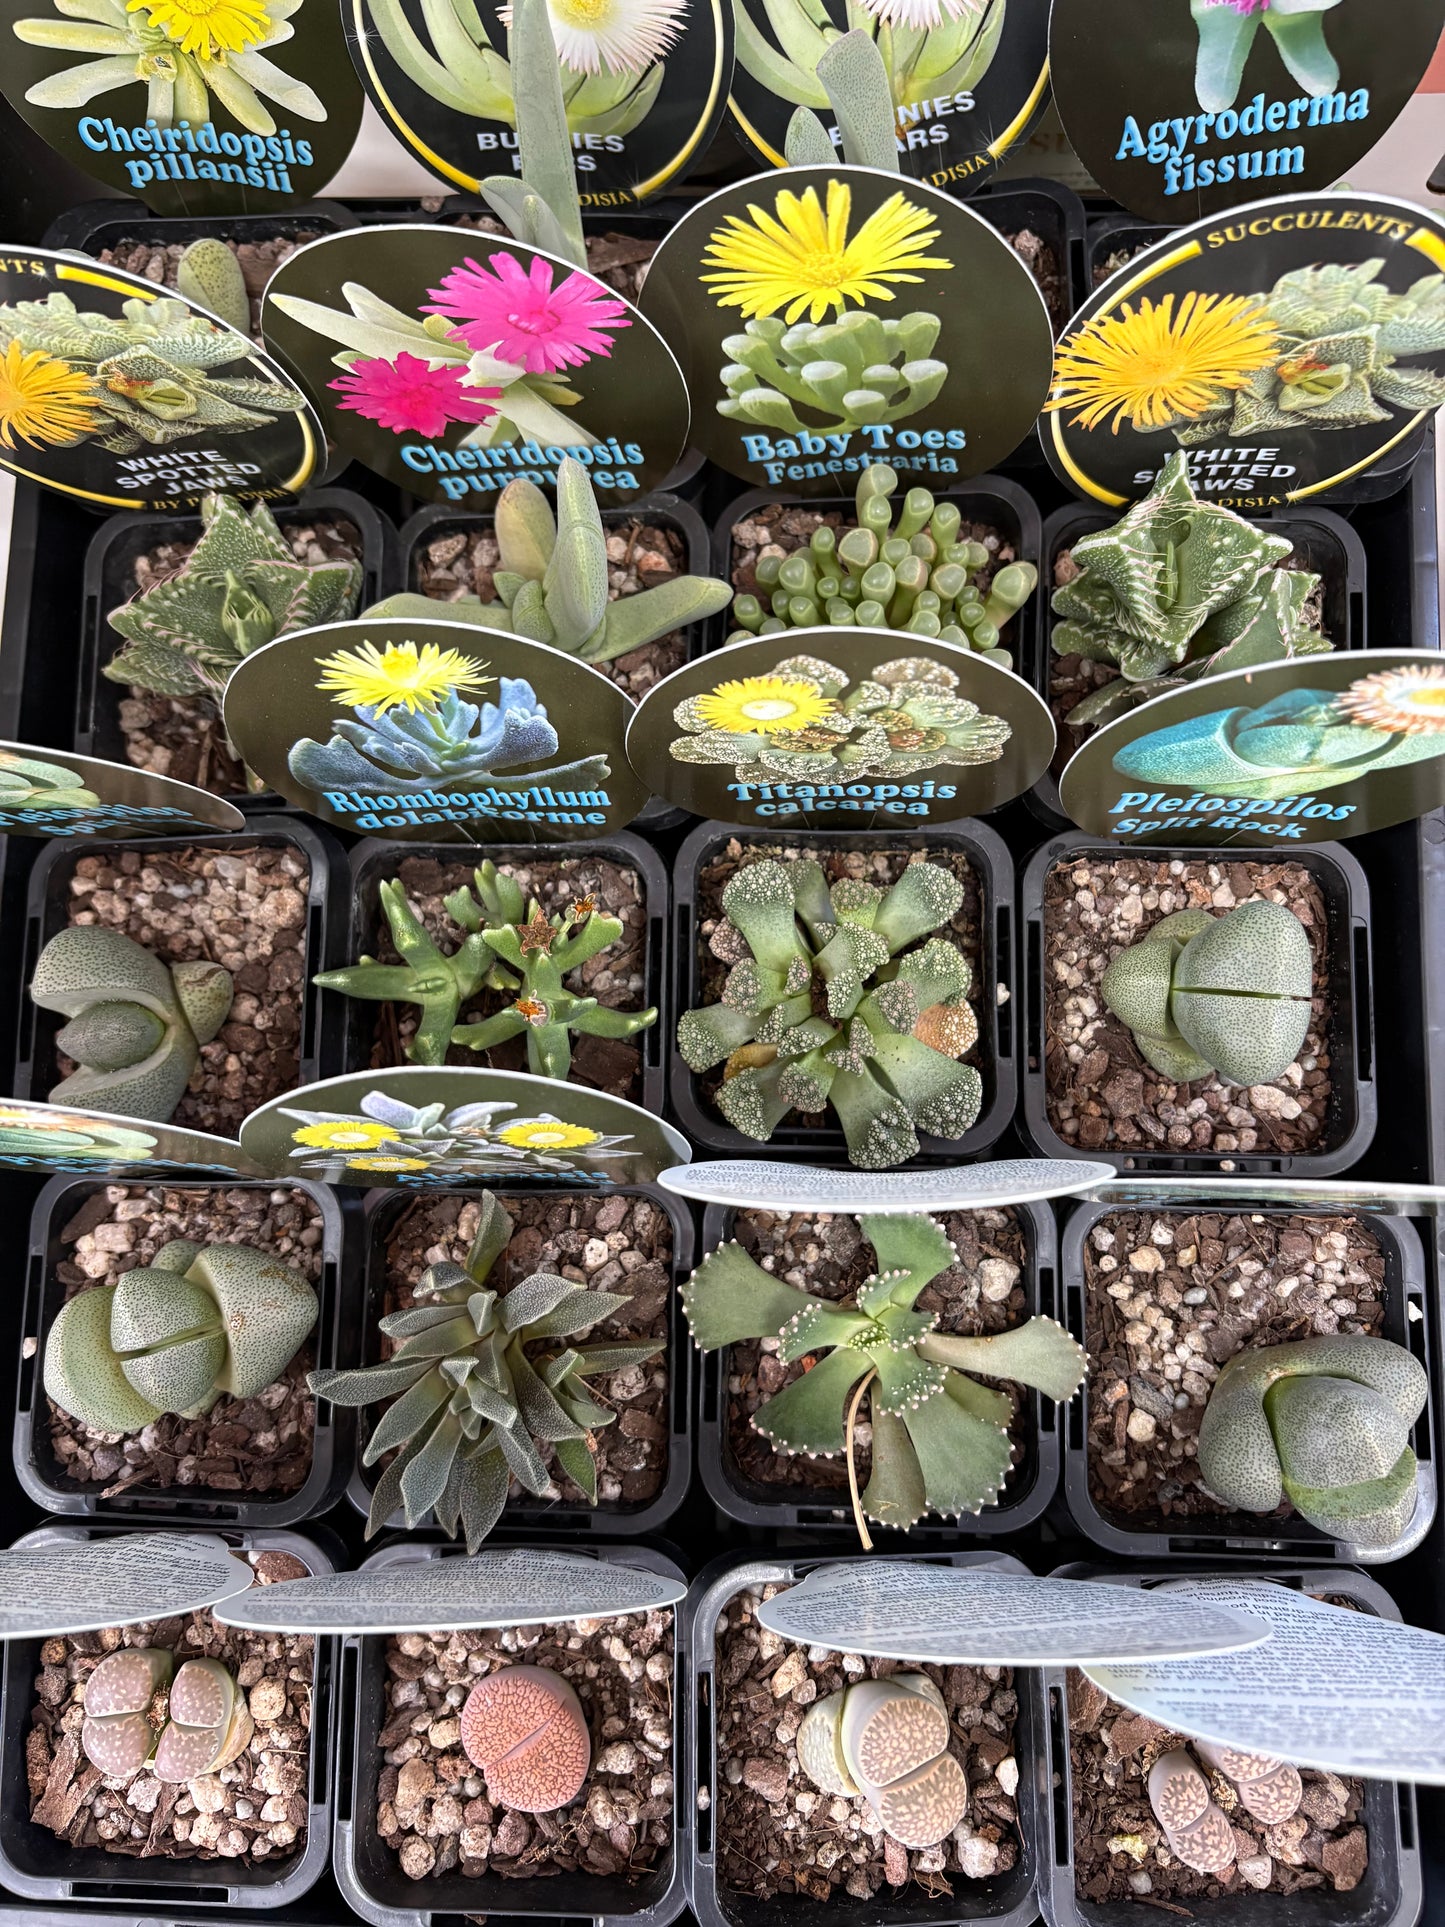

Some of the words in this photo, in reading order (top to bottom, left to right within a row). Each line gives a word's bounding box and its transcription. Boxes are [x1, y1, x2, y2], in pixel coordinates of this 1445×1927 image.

[1115, 87, 1370, 164] Agyroderma
[78, 116, 314, 167] Cheiridopsis
[476, 132, 625, 153] BUIES
[125, 152, 295, 194] pillansii
[1163, 145, 1305, 197] fissum
[1206, 209, 1413, 248] SUCCULENTS
[400, 437, 645, 473] Cheiridopsis
[741, 430, 852, 462] Baby
[862, 424, 967, 450] Toes
[116, 450, 228, 473] WHITE
[763, 451, 959, 485] Fenestraria
[1132, 464, 1296, 485] SOTTED
[116, 463, 262, 489] SPOTTED
[165, 475, 249, 495] JAWS
[153, 500, 180, 510] BY
[322, 786, 612, 813] Rhombophyllum
[727, 780, 958, 801] Titanopsis
[755, 798, 930, 816] calcarea
[1108, 792, 1357, 821] Pleiospilos
[1111, 816, 1205, 835] Split
[1208, 815, 1307, 839] Rock
